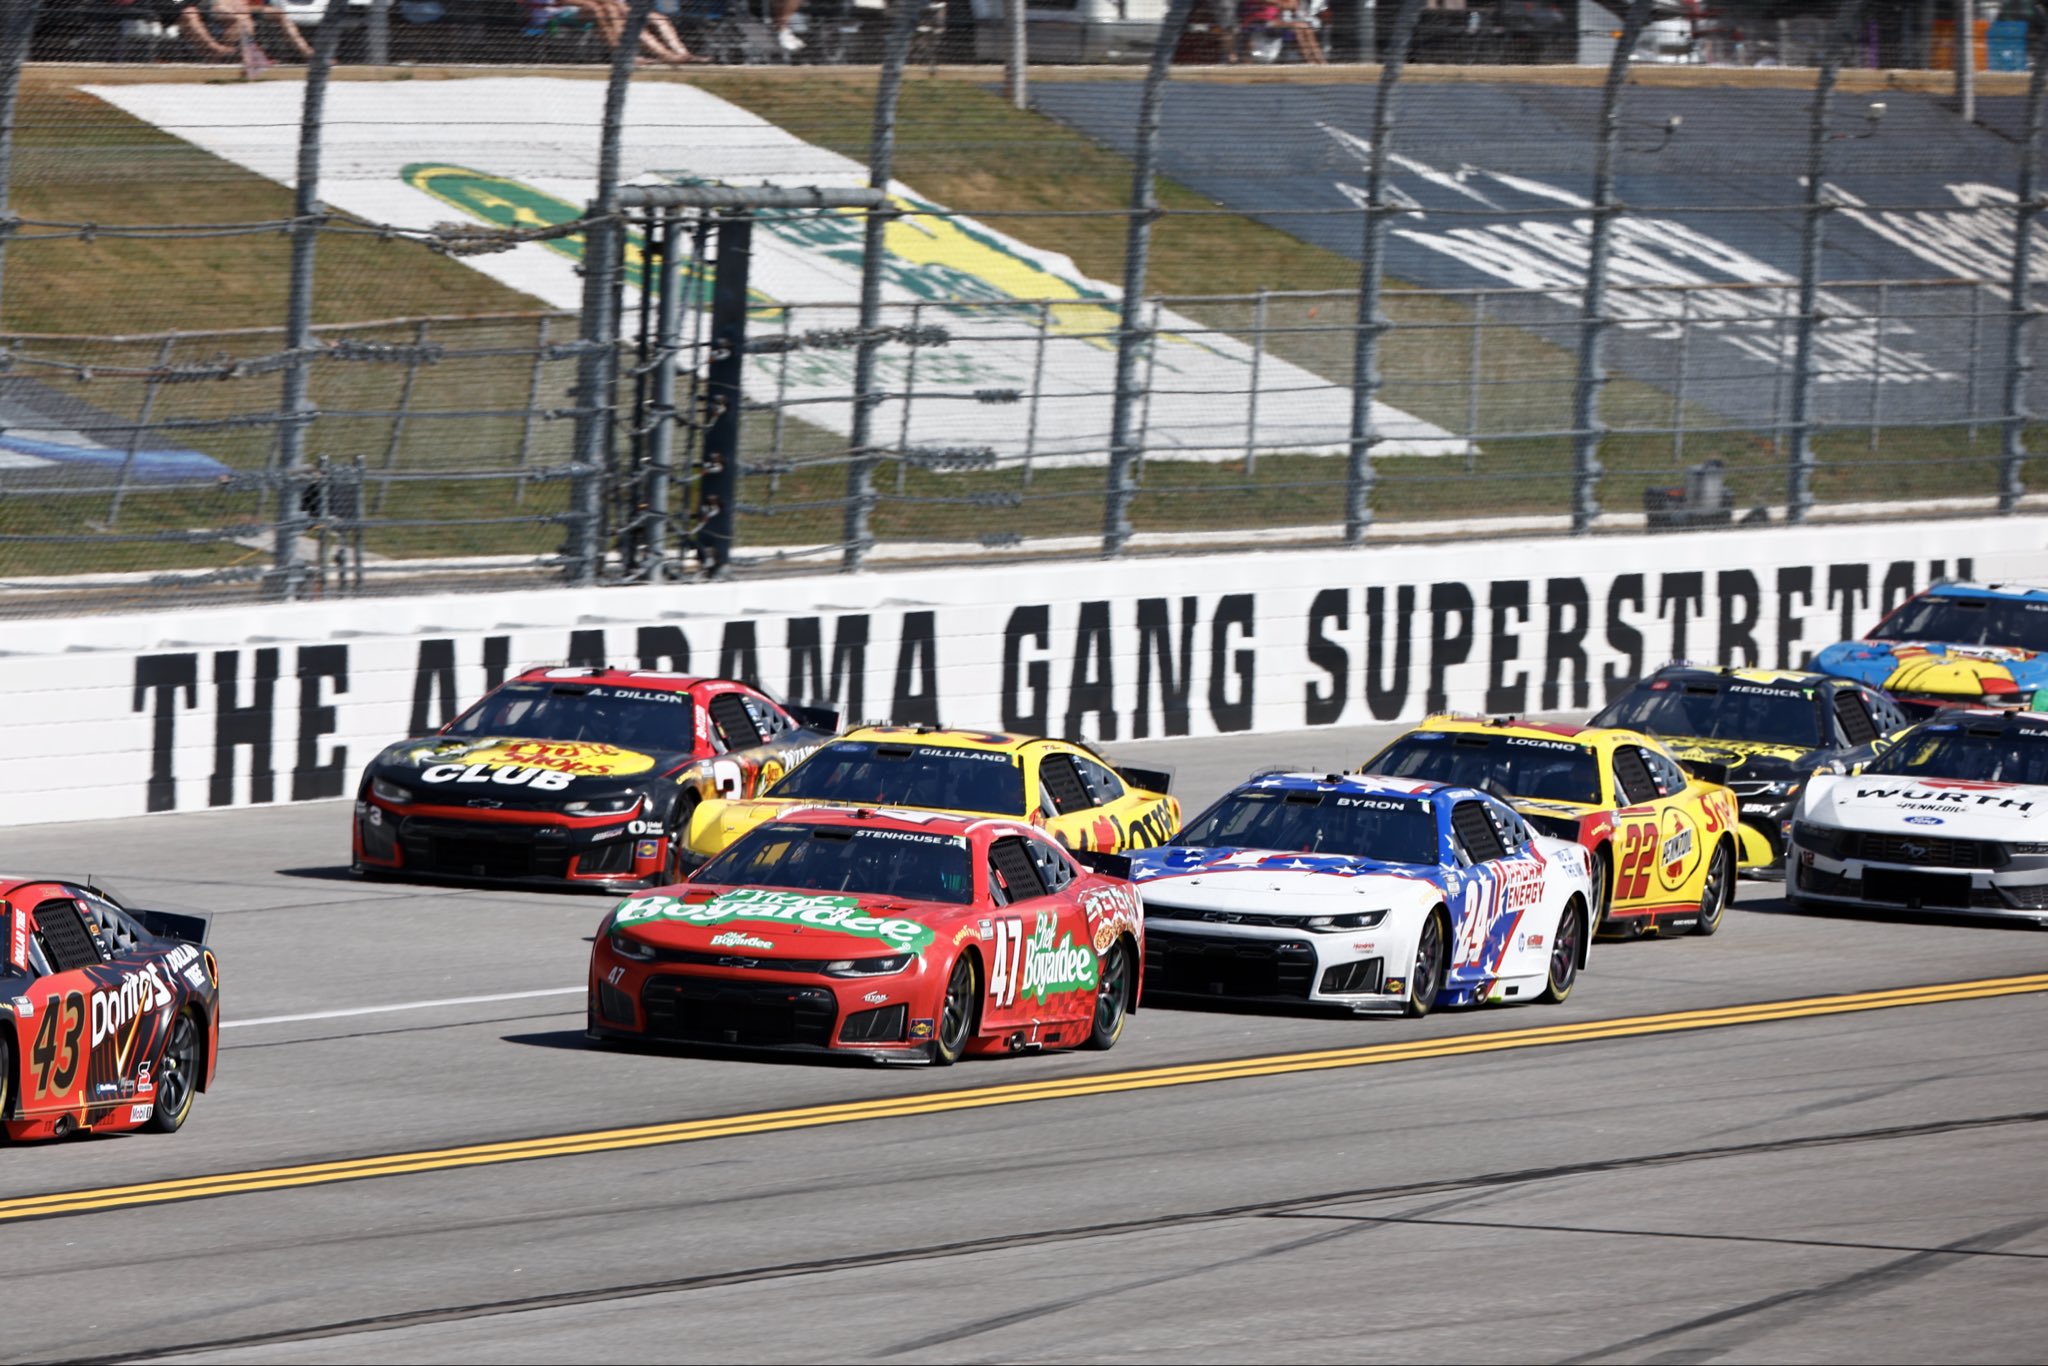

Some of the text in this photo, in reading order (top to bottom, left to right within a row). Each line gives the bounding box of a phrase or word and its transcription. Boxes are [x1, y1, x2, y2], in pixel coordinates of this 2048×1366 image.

[133, 645, 348, 813] THE
[1002, 593, 1255, 741] GANG
[614, 690, 682, 704] DILLON
[1730, 685, 1801, 698] REDDICK
[919, 748, 1007, 762] GILLILAND
[1506, 738, 1576, 751] LOGANO
[421, 763, 576, 791] CLUB
[370, 805, 382, 826] 3
[1337, 798, 1404, 811] BYRON
[1901, 803, 1961, 813] PENNZOIL
[1910, 816, 1939, 825] Ford
[855, 829, 942, 844] STENHOUSE
[1615, 822, 1659, 900] 22
[1508, 881, 1546, 908] ENERGY
[615, 895, 922, 941] Boyardee
[1034, 911, 1058, 950] Chef
[1454, 880, 1492, 966] 24
[14, 930, 26, 967] DOLLAR
[711, 935, 773, 949] Boyardee
[165, 943, 199, 974] DOLLAR
[990, 918, 1022, 1008] 47
[1022, 934, 1092, 996] Boyardee
[607, 966, 625, 985] 47
[92, 962, 172, 1049] Doritos
[30, 989, 85, 1099] 43
